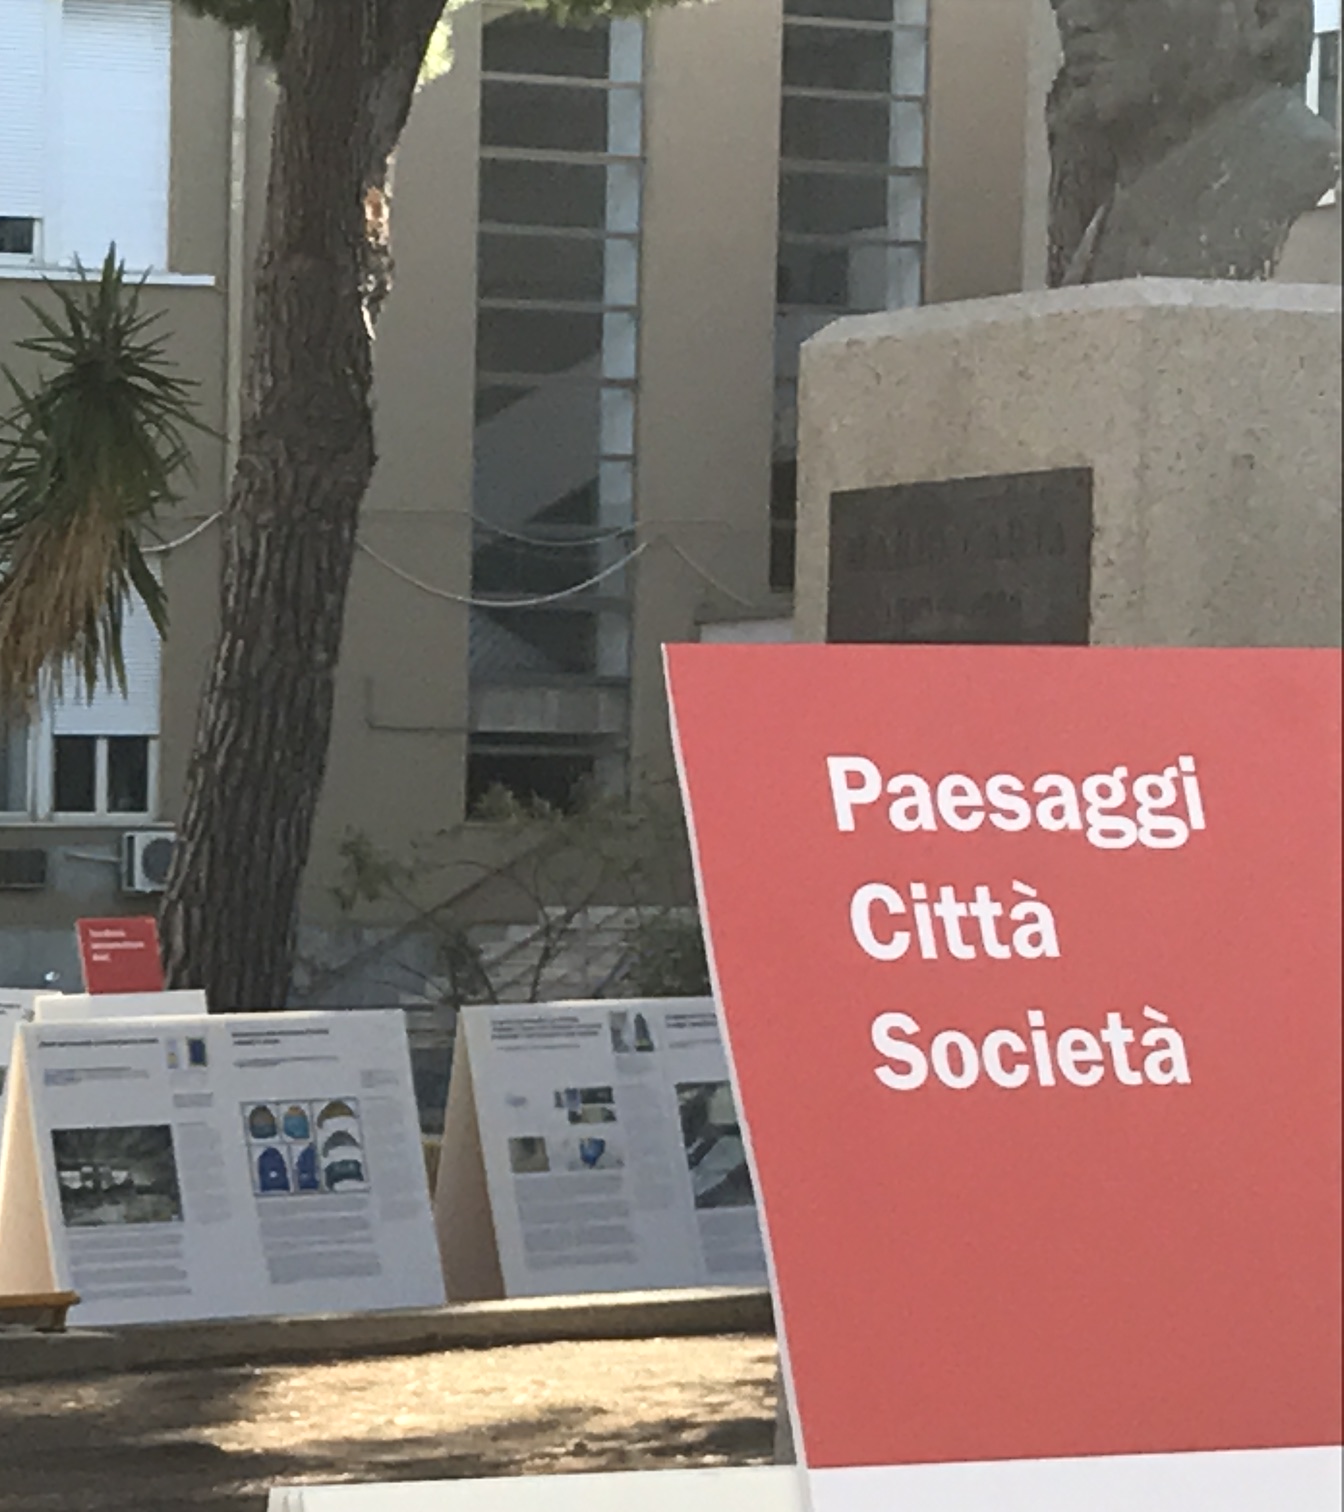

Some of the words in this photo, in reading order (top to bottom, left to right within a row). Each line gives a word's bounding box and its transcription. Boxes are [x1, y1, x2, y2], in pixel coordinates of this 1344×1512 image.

[826, 754, 1206, 849] Paesaggi
[849, 879, 1061, 960] Città
[870, 1005, 1192, 1090] Società
